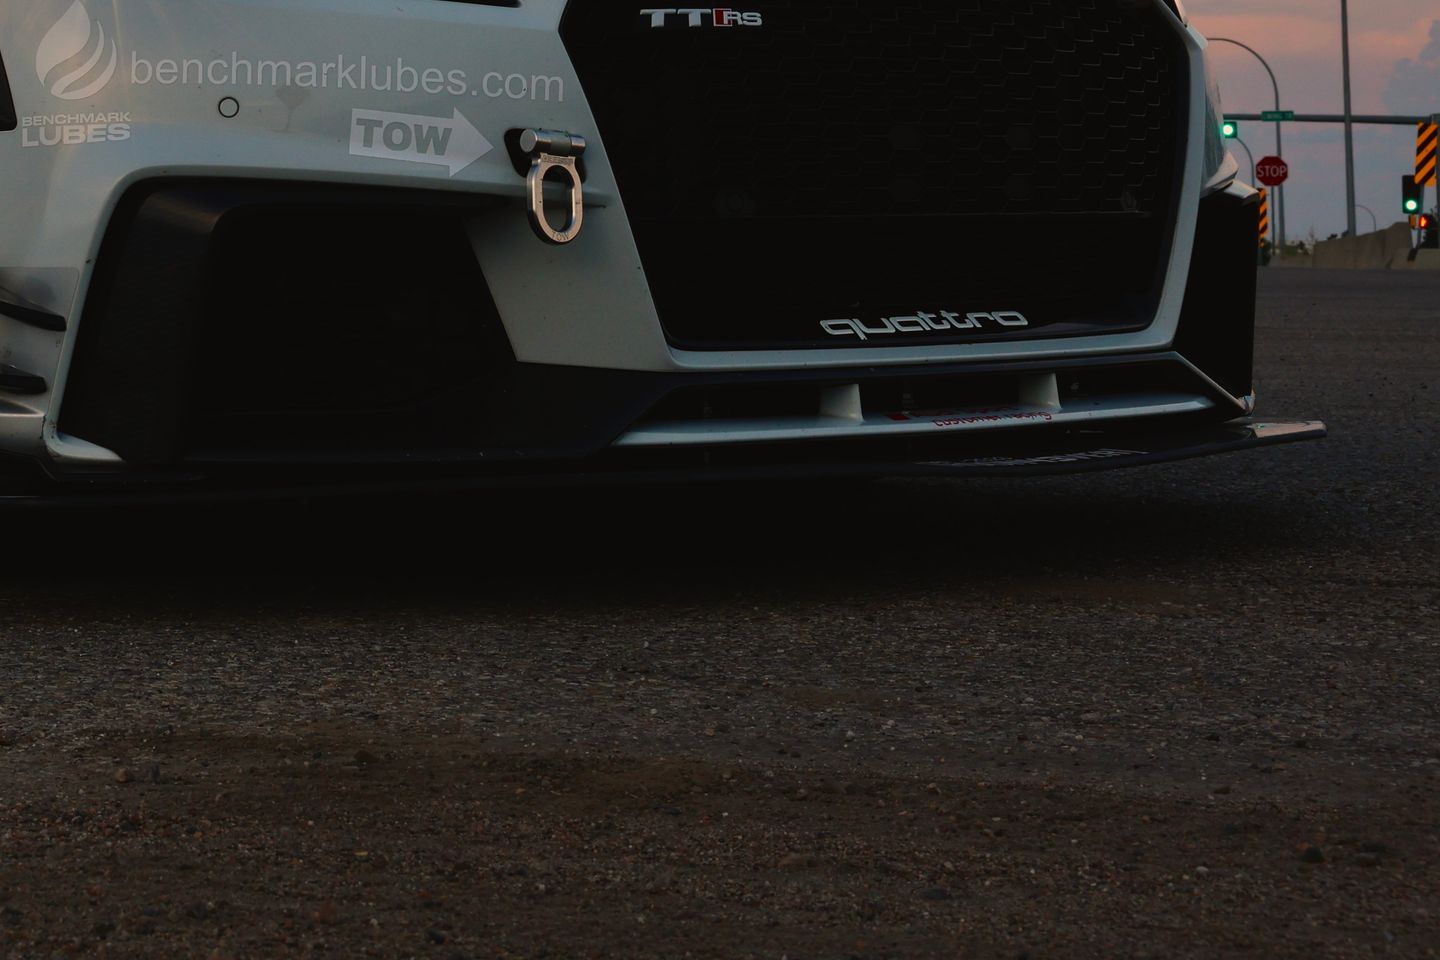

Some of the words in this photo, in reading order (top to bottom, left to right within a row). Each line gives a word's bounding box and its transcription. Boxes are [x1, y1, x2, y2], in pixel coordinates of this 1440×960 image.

[131, 51, 565, 103] benchmarklubes.com
[22, 111, 132, 127] BENCHMARK
[21, 123, 131, 148] LUBES
[355, 117, 453, 156] TOW
[1256, 165, 1287, 178] STOP
[820, 309, 1029, 340] quattro
